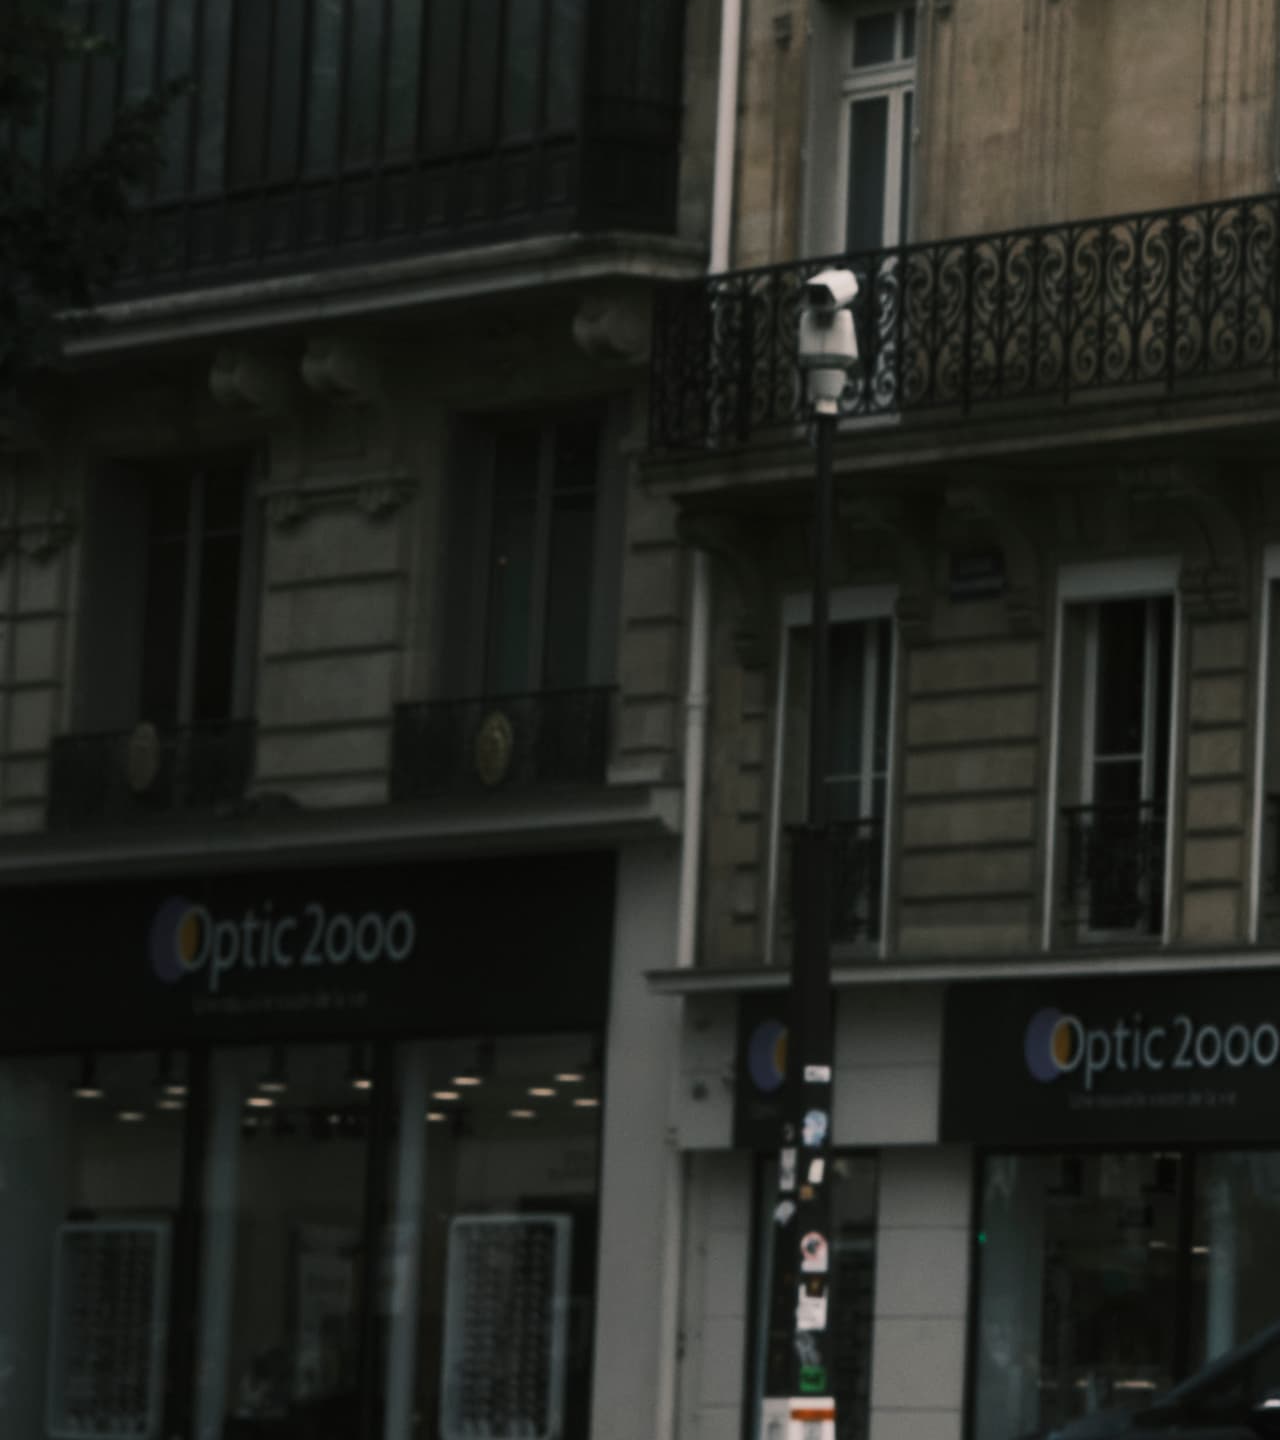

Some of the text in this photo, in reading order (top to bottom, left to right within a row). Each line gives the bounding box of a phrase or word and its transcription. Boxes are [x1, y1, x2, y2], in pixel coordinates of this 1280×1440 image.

[177, 898, 416, 992] Optic 2000
[1050, 1011, 1168, 1091] Optic
